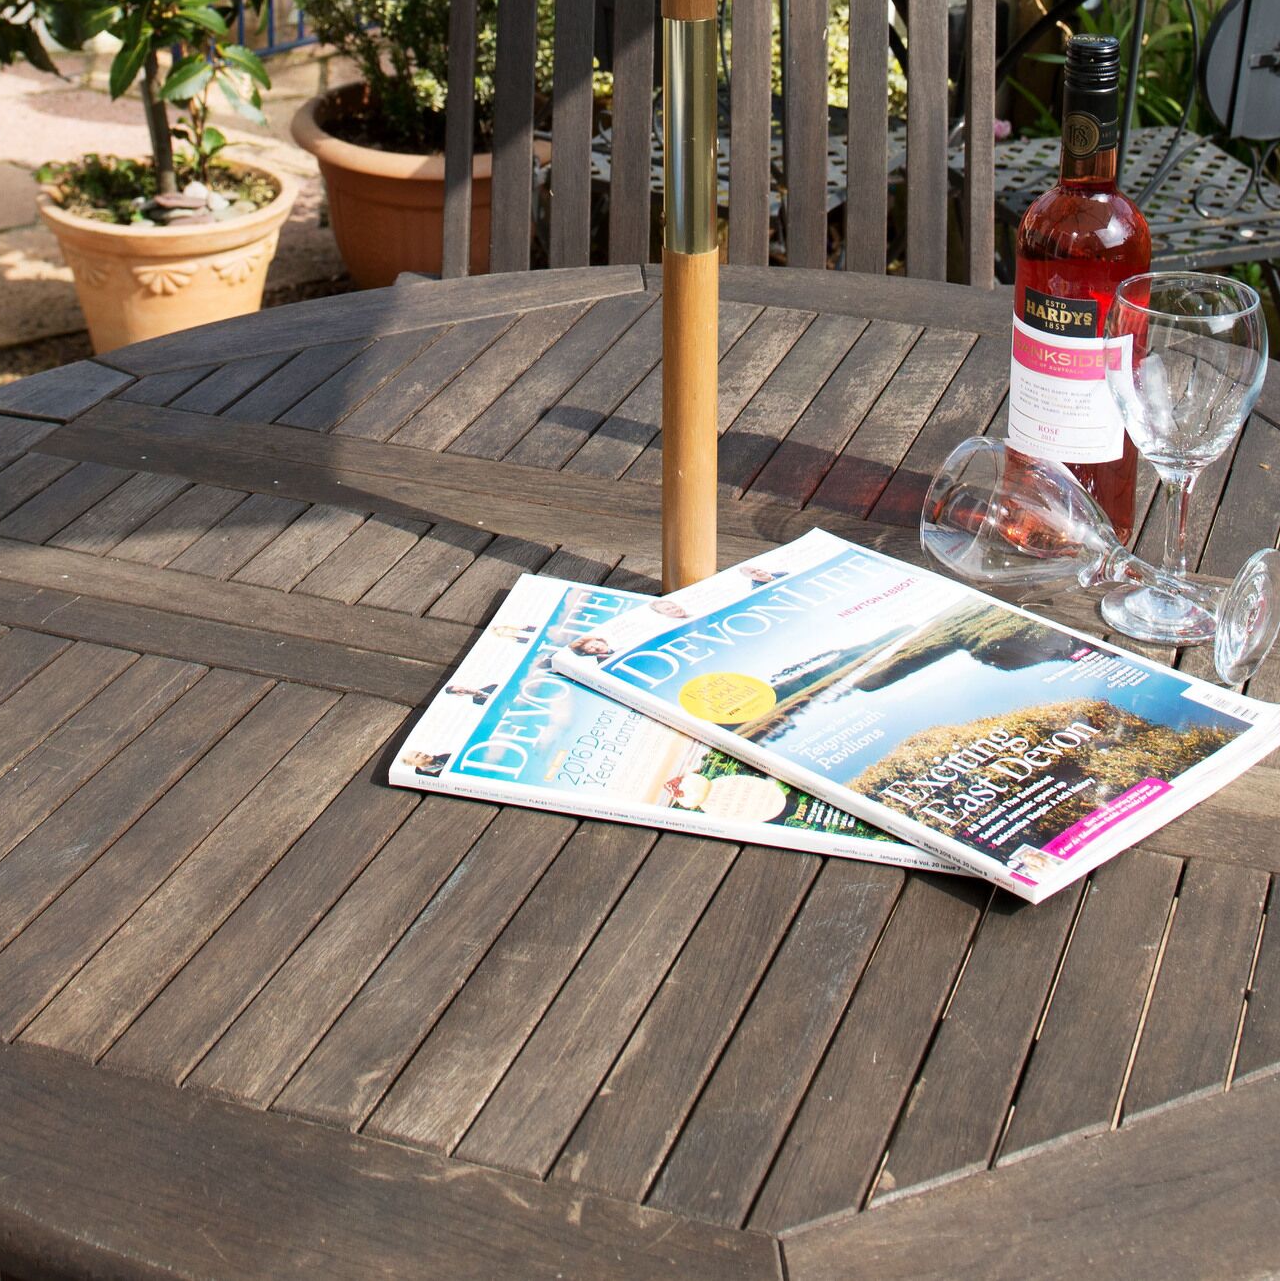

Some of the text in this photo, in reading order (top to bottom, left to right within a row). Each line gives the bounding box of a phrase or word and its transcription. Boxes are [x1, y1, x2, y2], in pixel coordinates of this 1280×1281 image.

[1026, 299, 1093, 326] HARDYS
[1045, 299, 1067, 309] ESTD
[1045, 321, 1066, 331] 1853
[838, 594, 882, 618] NEWTON
[558, 749, 593, 786] 2016
[577, 709, 618, 749] Devon
[583, 756, 617, 787] Year
[602, 709, 643, 755] Planne
[801, 710, 887, 759] Teignmouth
[816, 729, 885, 771] Pavilions
[881, 728, 1029, 808] Exciting
[921, 777, 1009, 828] East
[991, 721, 1101, 782] Devon
[879, 852, 902, 863] January
[919, 858, 930, 867] Vol.
[940, 862, 956, 870] Issue
